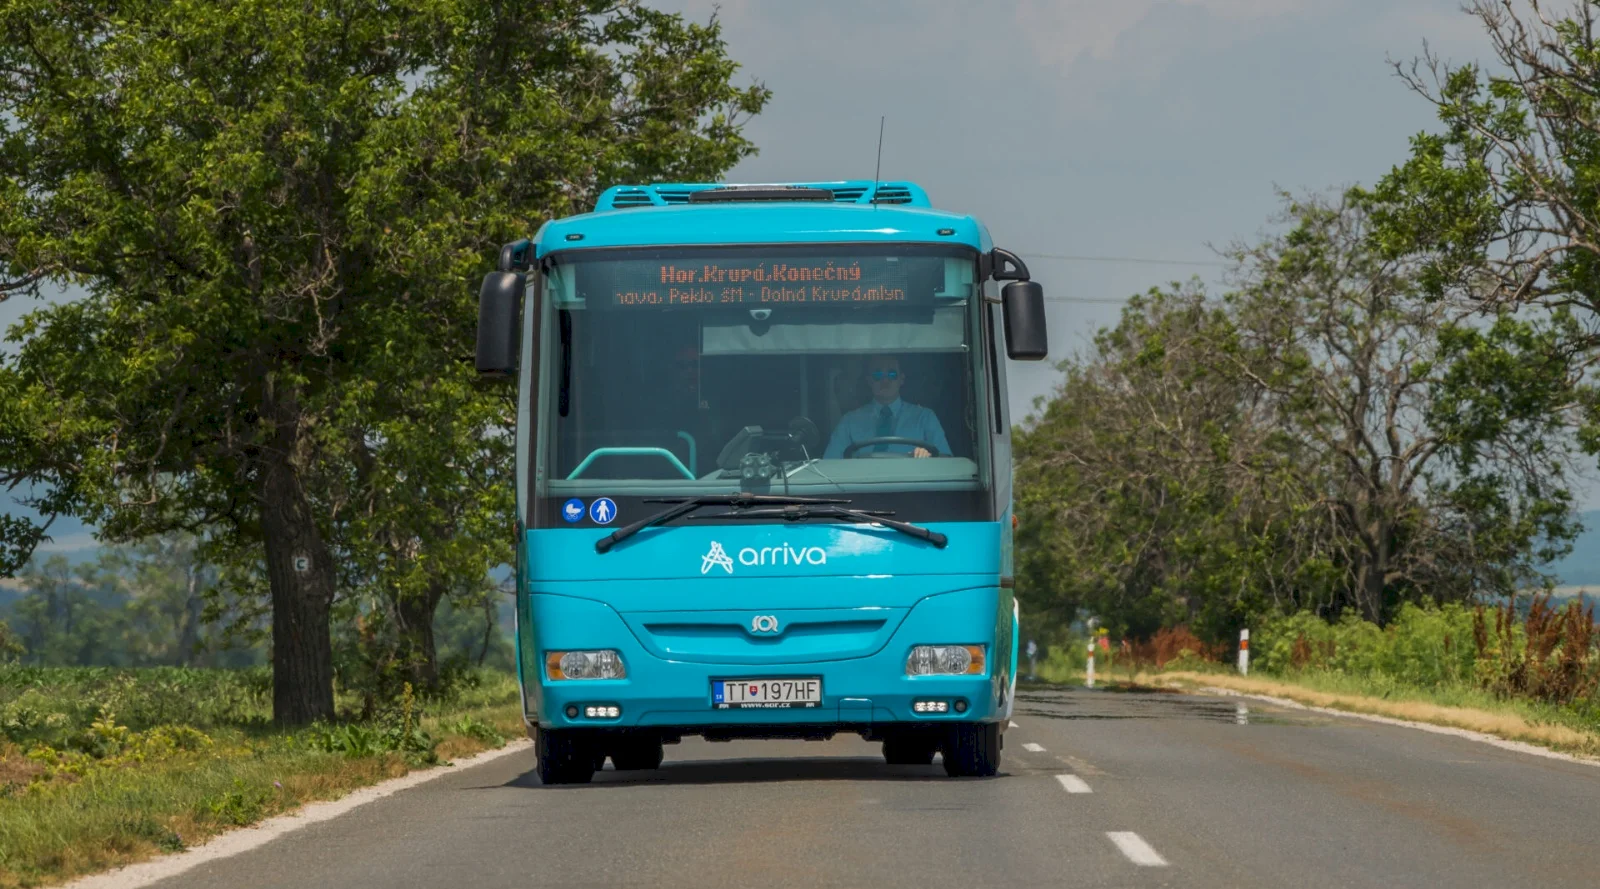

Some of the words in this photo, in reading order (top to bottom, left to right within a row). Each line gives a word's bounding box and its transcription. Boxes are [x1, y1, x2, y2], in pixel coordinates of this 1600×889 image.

[669, 287, 714, 304] Peklo
[761, 285, 806, 302] Dolná
[738, 541, 827, 566] arriva
[726, 683, 748, 701] TT
[761, 681, 817, 700] 197HF
